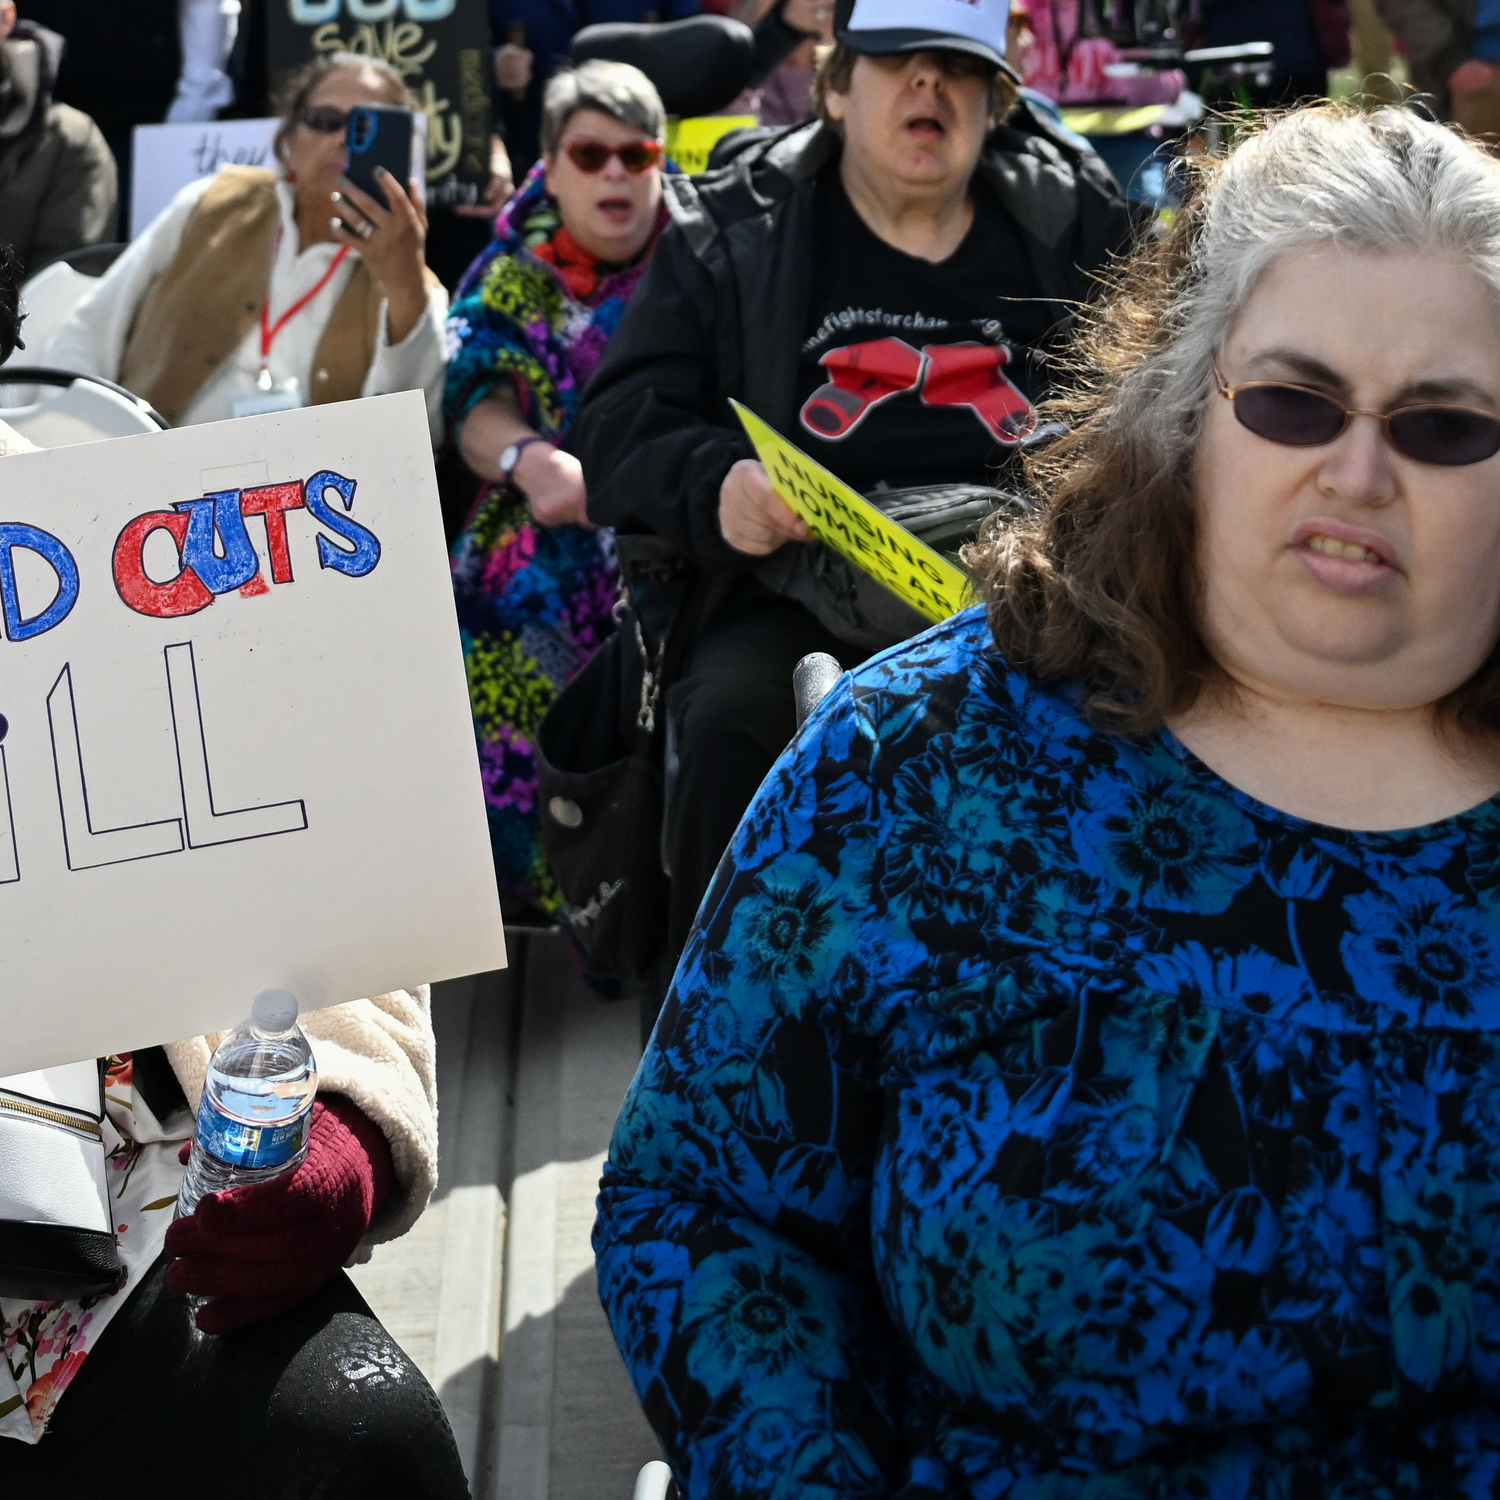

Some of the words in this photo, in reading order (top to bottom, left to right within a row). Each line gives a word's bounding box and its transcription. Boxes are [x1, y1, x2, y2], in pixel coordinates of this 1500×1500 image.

[110, 468, 382, 619] CUTS
[773, 465, 898, 576] HOMES
[778, 450, 944, 586] NURSING
